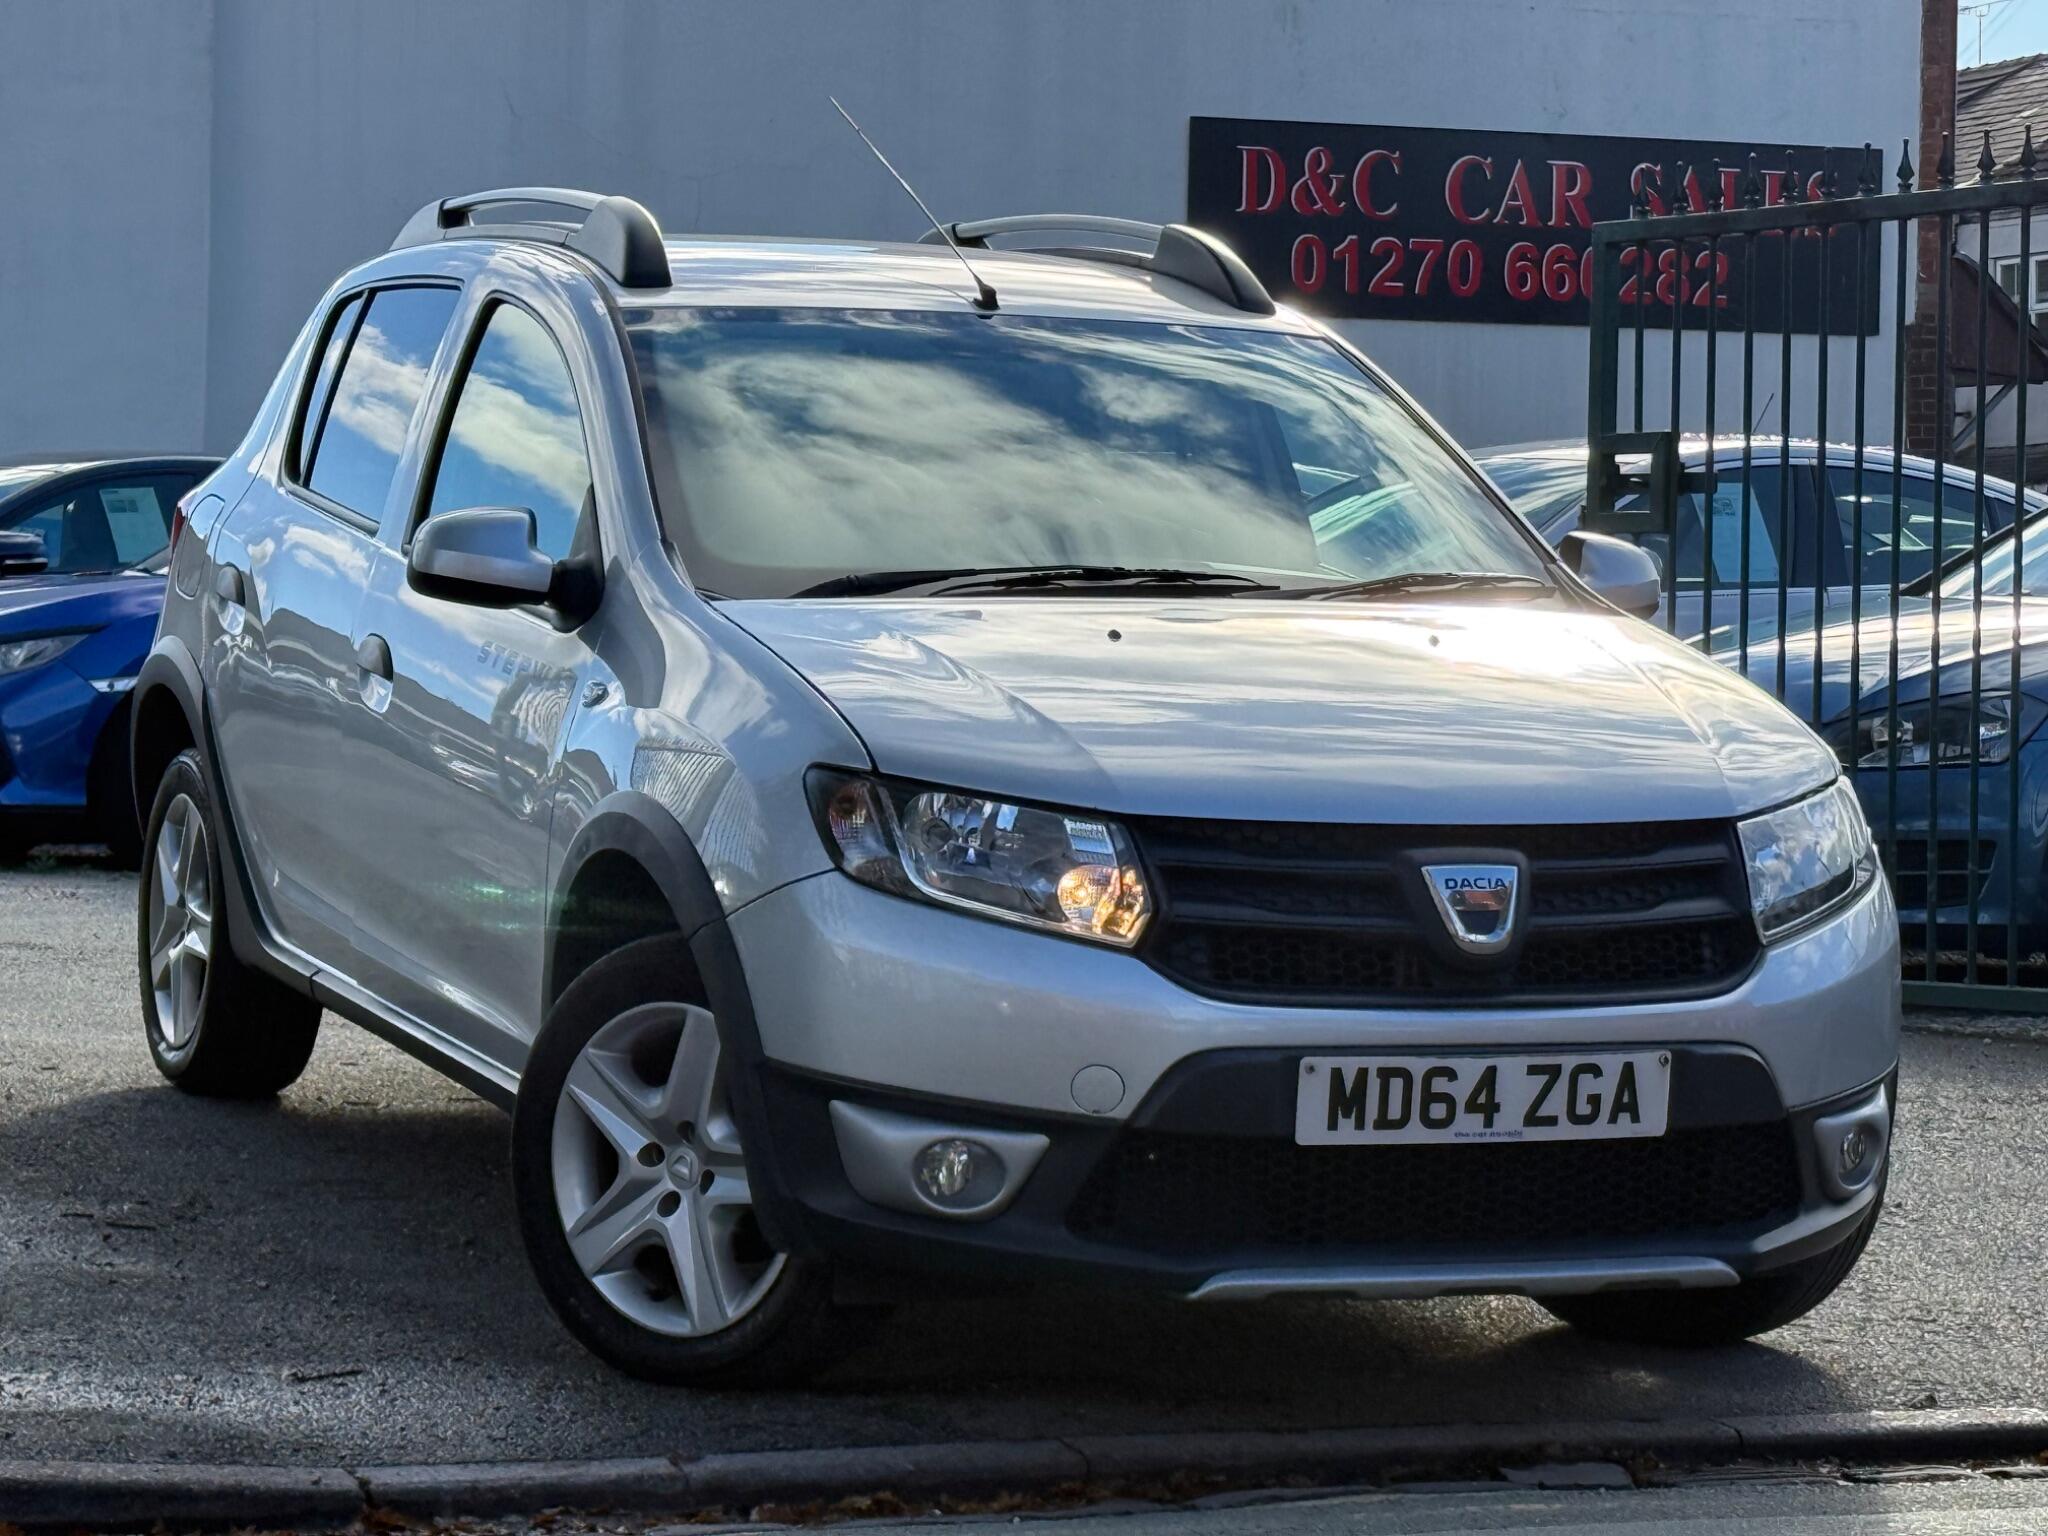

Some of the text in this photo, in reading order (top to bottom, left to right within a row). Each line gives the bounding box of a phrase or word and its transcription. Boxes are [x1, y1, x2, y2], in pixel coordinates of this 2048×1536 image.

[1235, 145, 1402, 220] D&C
[1445, 154, 1593, 229] CAR
[1290, 233, 1483, 296] 01270
[1618, 245, 1729, 308] 282
[477, 639, 573, 692] STEPW
[1444, 877, 1508, 890] DACIA
[1327, 1061, 1641, 1131] MD64 ZGA
